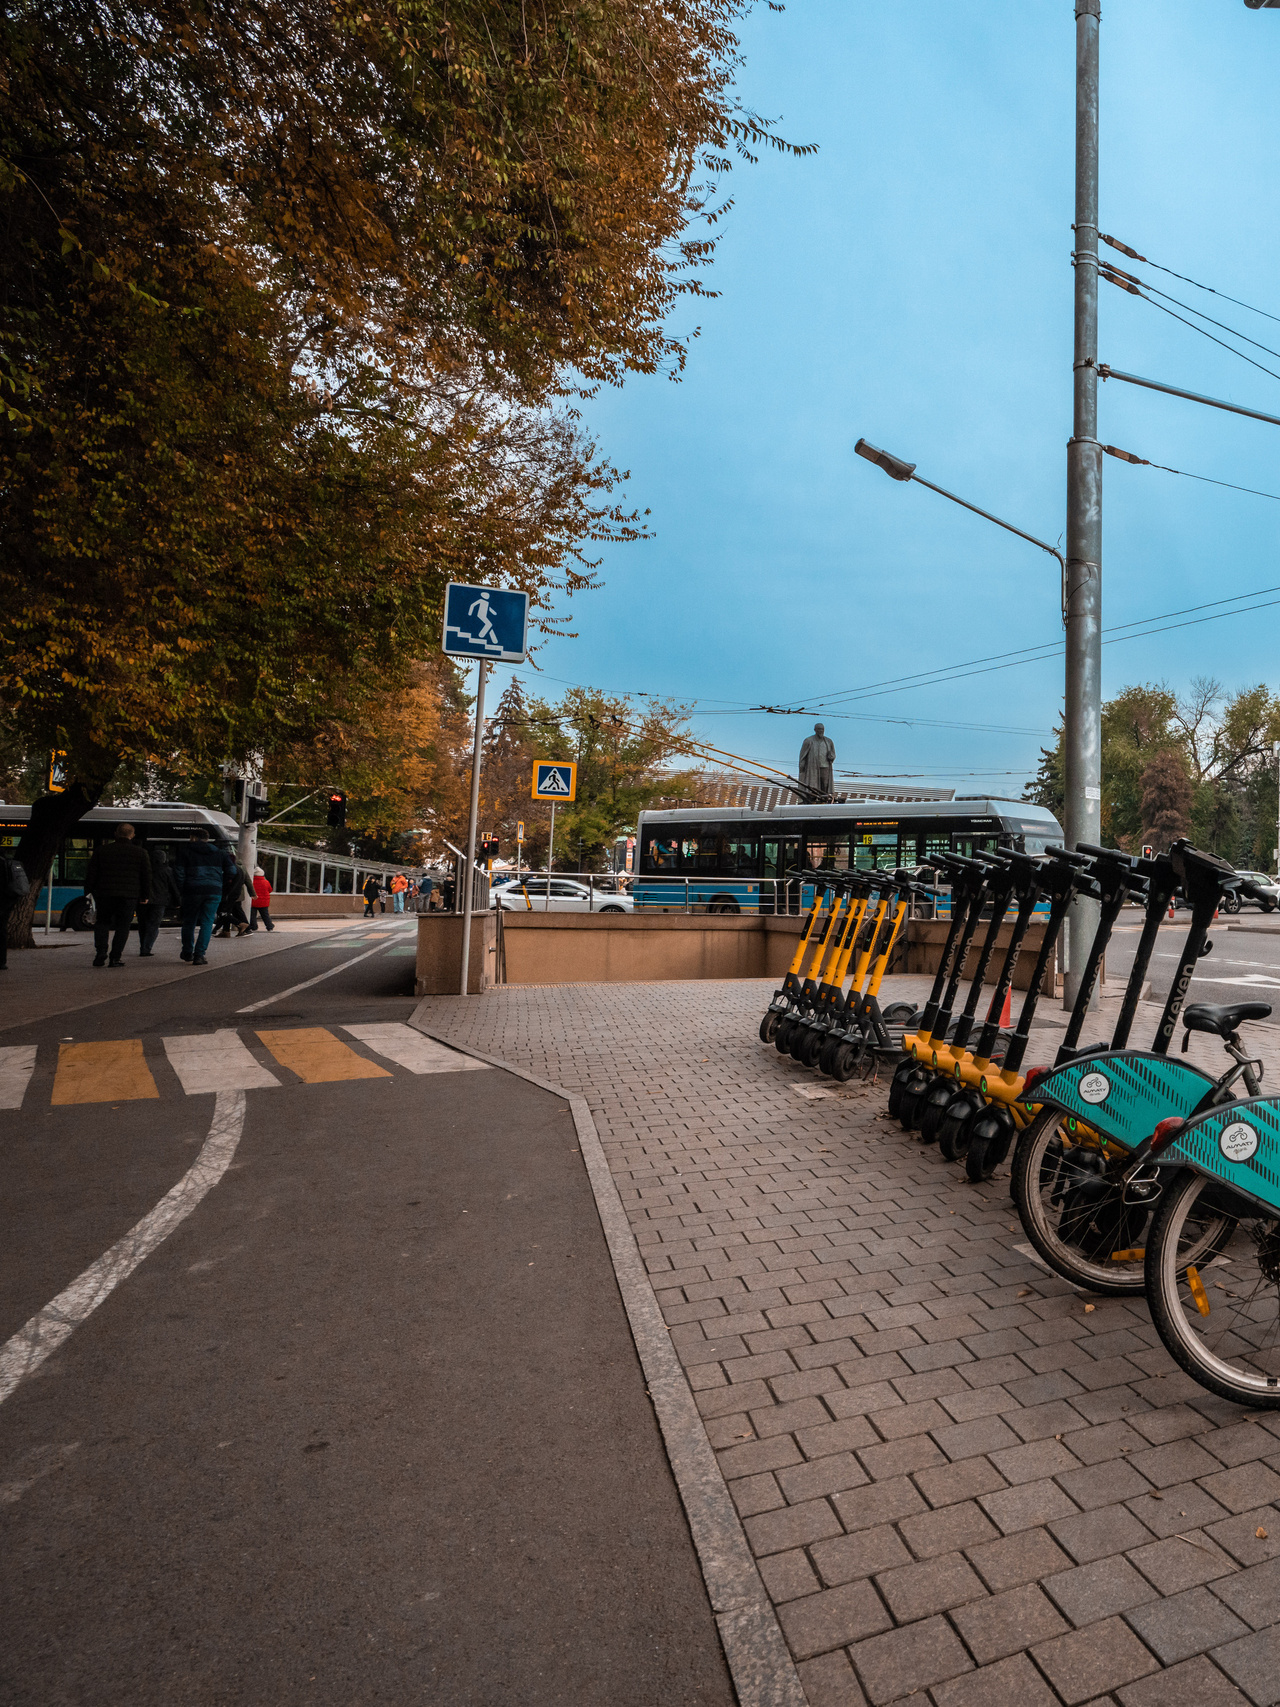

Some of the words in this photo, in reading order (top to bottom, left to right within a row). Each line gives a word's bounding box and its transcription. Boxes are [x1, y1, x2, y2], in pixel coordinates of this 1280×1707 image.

[482, 833, 491, 841] 16
[864, 835, 872, 844] 19
[1163, 963, 1195, 1038] eleven
[1226, 1141, 1253, 1150] ALMATY
